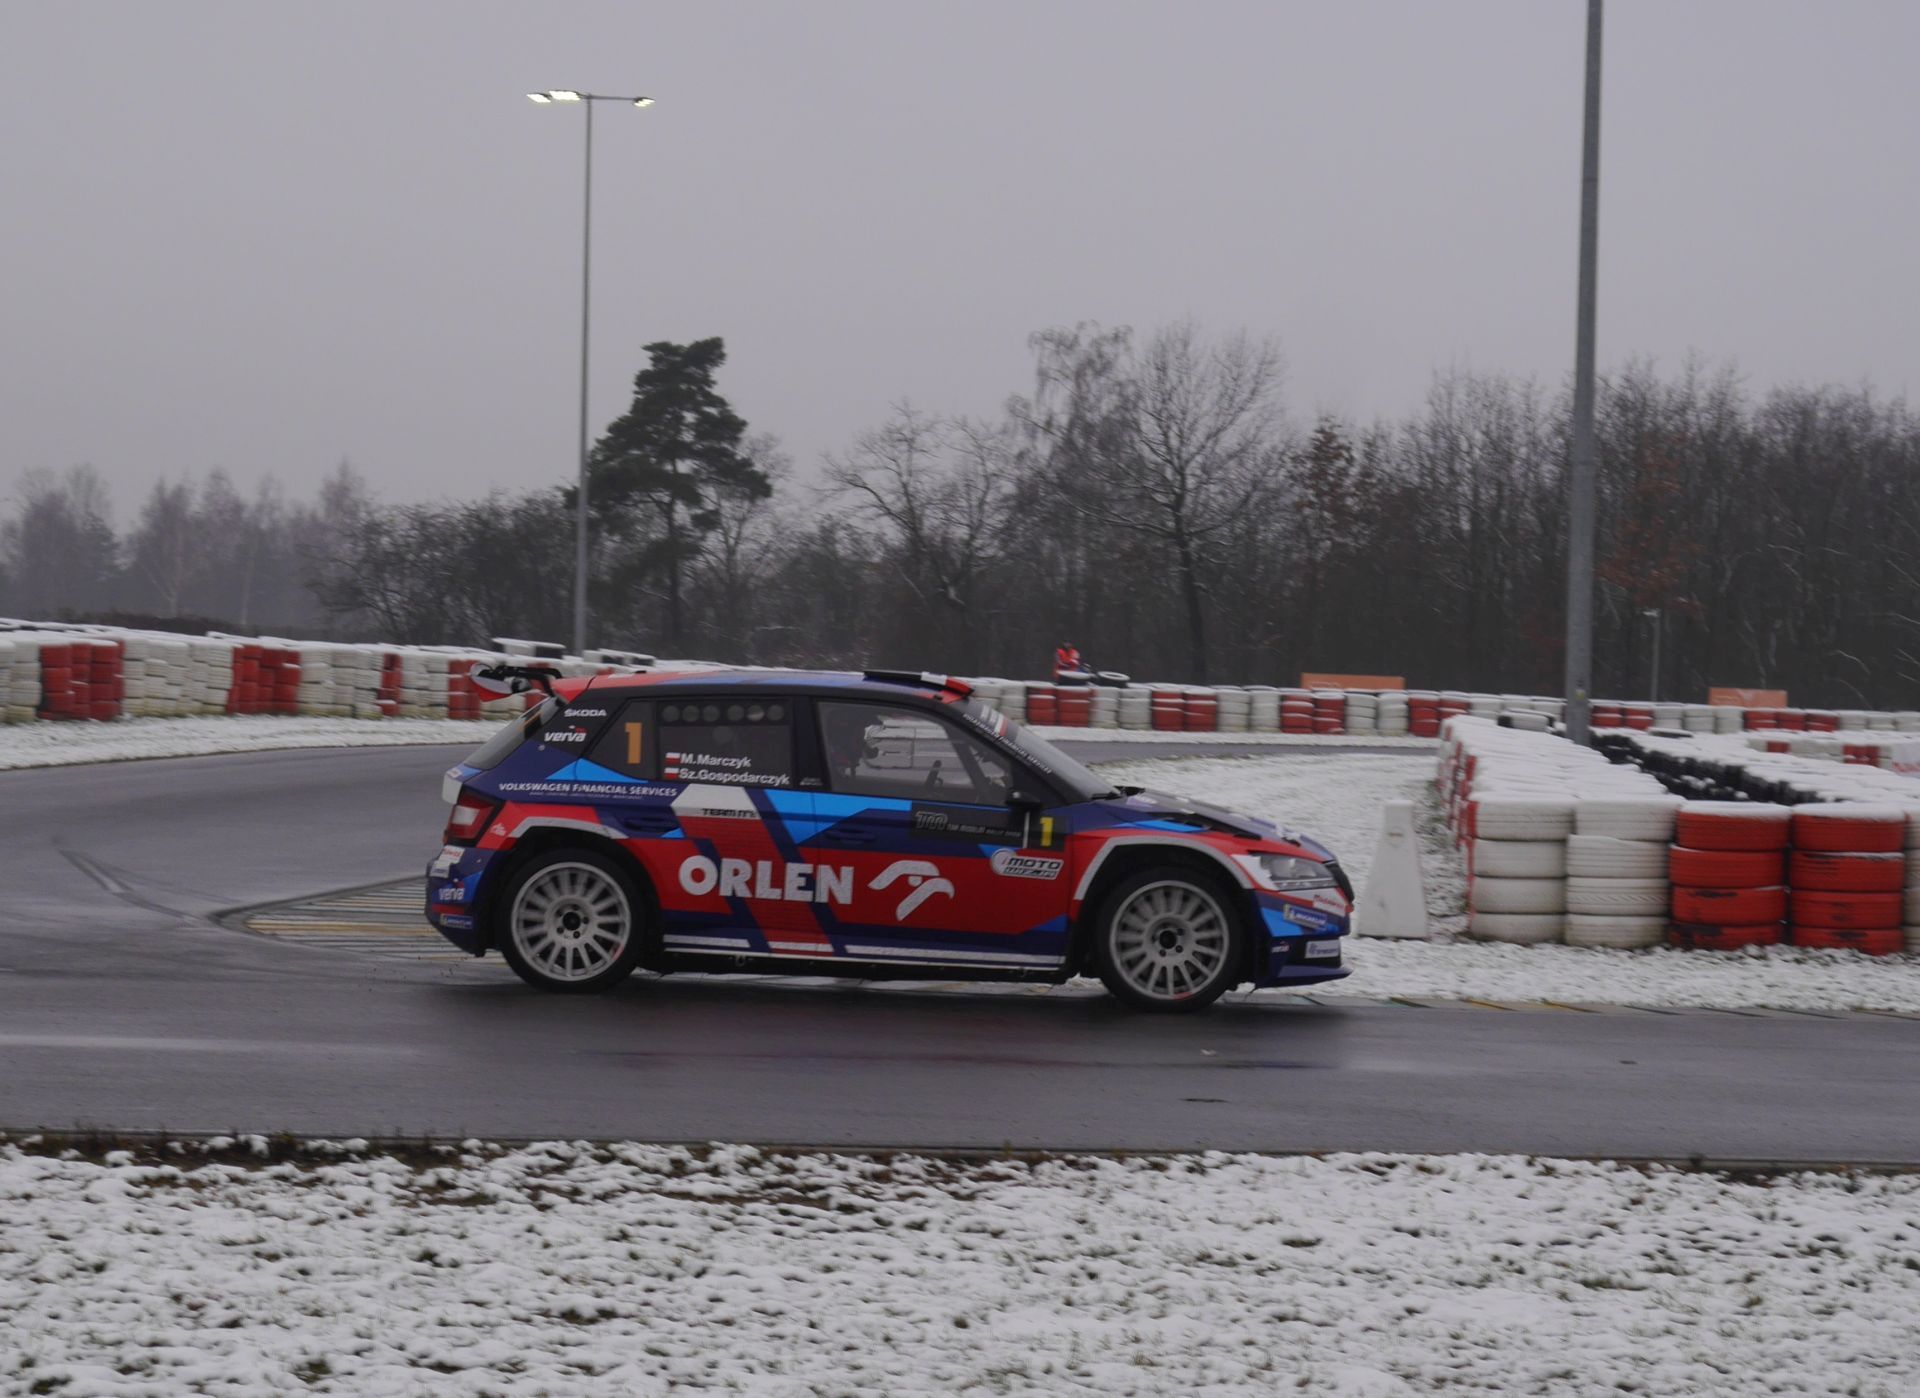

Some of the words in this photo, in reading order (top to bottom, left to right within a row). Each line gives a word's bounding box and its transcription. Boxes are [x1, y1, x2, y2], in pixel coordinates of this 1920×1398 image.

[544, 731, 587, 742] verva
[624, 722, 642, 764] 1
[680, 753, 752, 769] M.Marczyk
[679, 768, 790, 786] Sz.Gospodarczyk
[499, 783, 570, 792] VOLKSWAGEN
[572, 784, 627, 794] FINANCIAL
[629, 786, 677, 797] SERVICES
[1040, 816, 1053, 846] 1
[1008, 857, 1061, 869] MOTO
[678, 855, 855, 905] ORLEN
